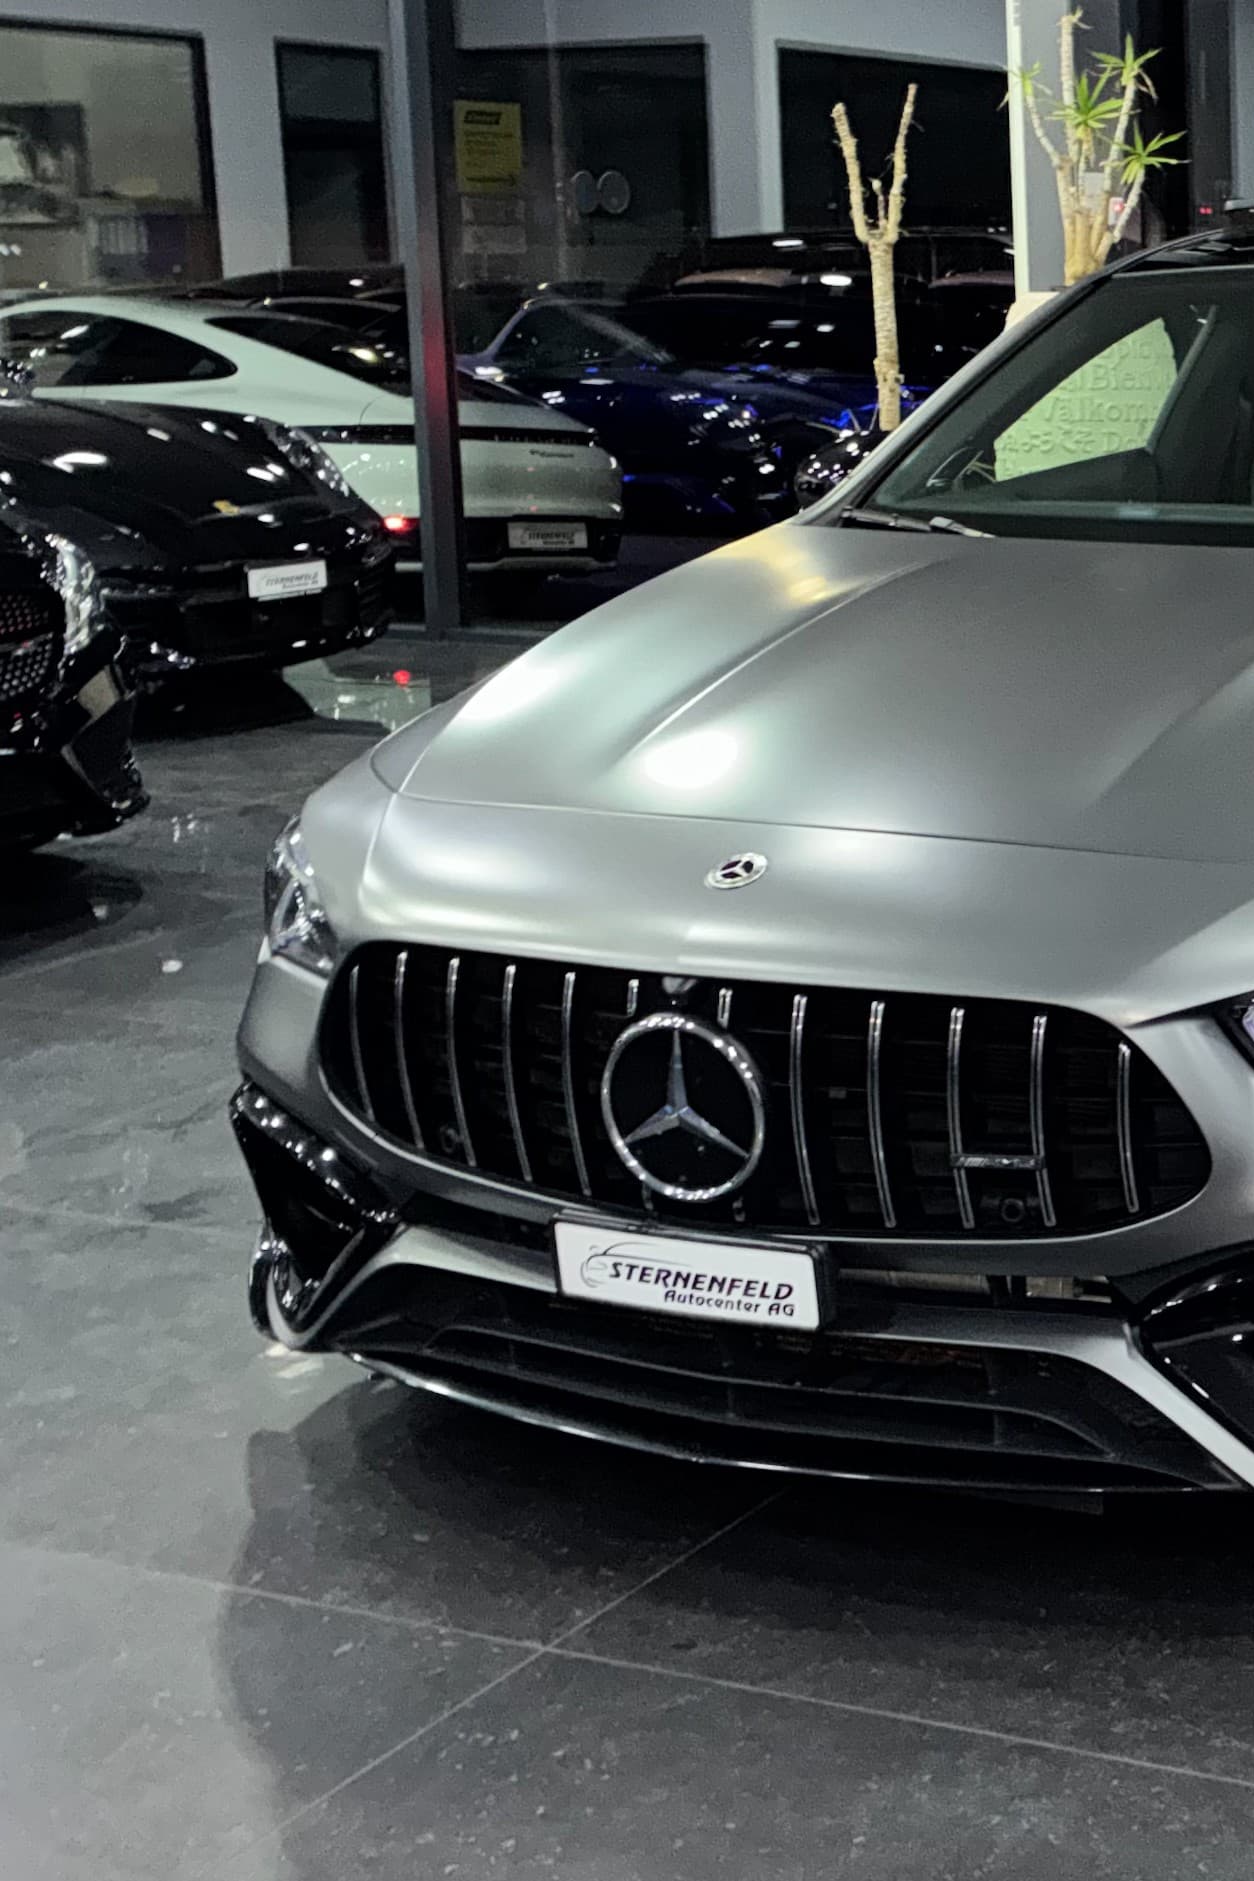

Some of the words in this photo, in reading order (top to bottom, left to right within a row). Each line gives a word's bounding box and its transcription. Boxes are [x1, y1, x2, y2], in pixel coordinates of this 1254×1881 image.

[609, 1262, 794, 1300] STERNENFELD
[664, 1289, 760, 1314] Autocenter
[768, 1303, 795, 1317] AG
